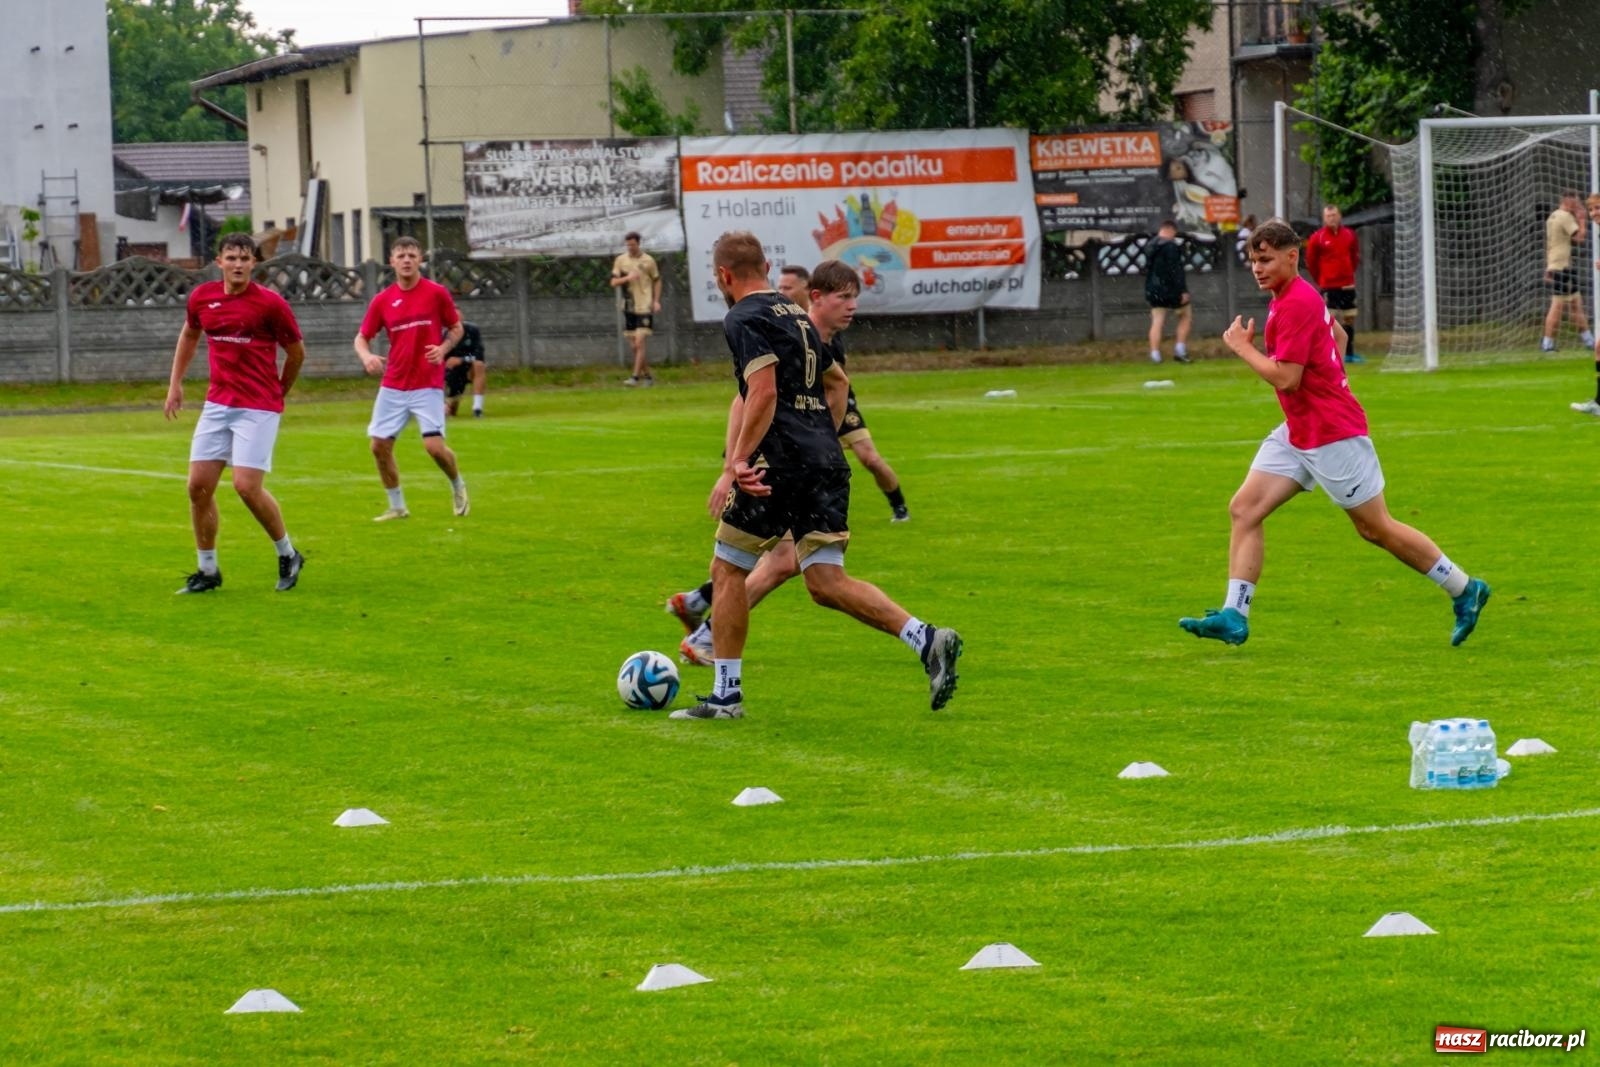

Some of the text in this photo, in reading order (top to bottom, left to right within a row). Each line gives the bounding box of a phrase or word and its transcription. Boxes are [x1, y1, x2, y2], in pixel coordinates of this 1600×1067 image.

[1036, 135, 1155, 157] KREWETKA
[696, 154, 944, 185] Rozliczenie podatku
[701, 196, 796, 219] z Holandii
[946, 222, 1009, 237] emerytury
[911, 275, 1025, 296] dutchables.pl
